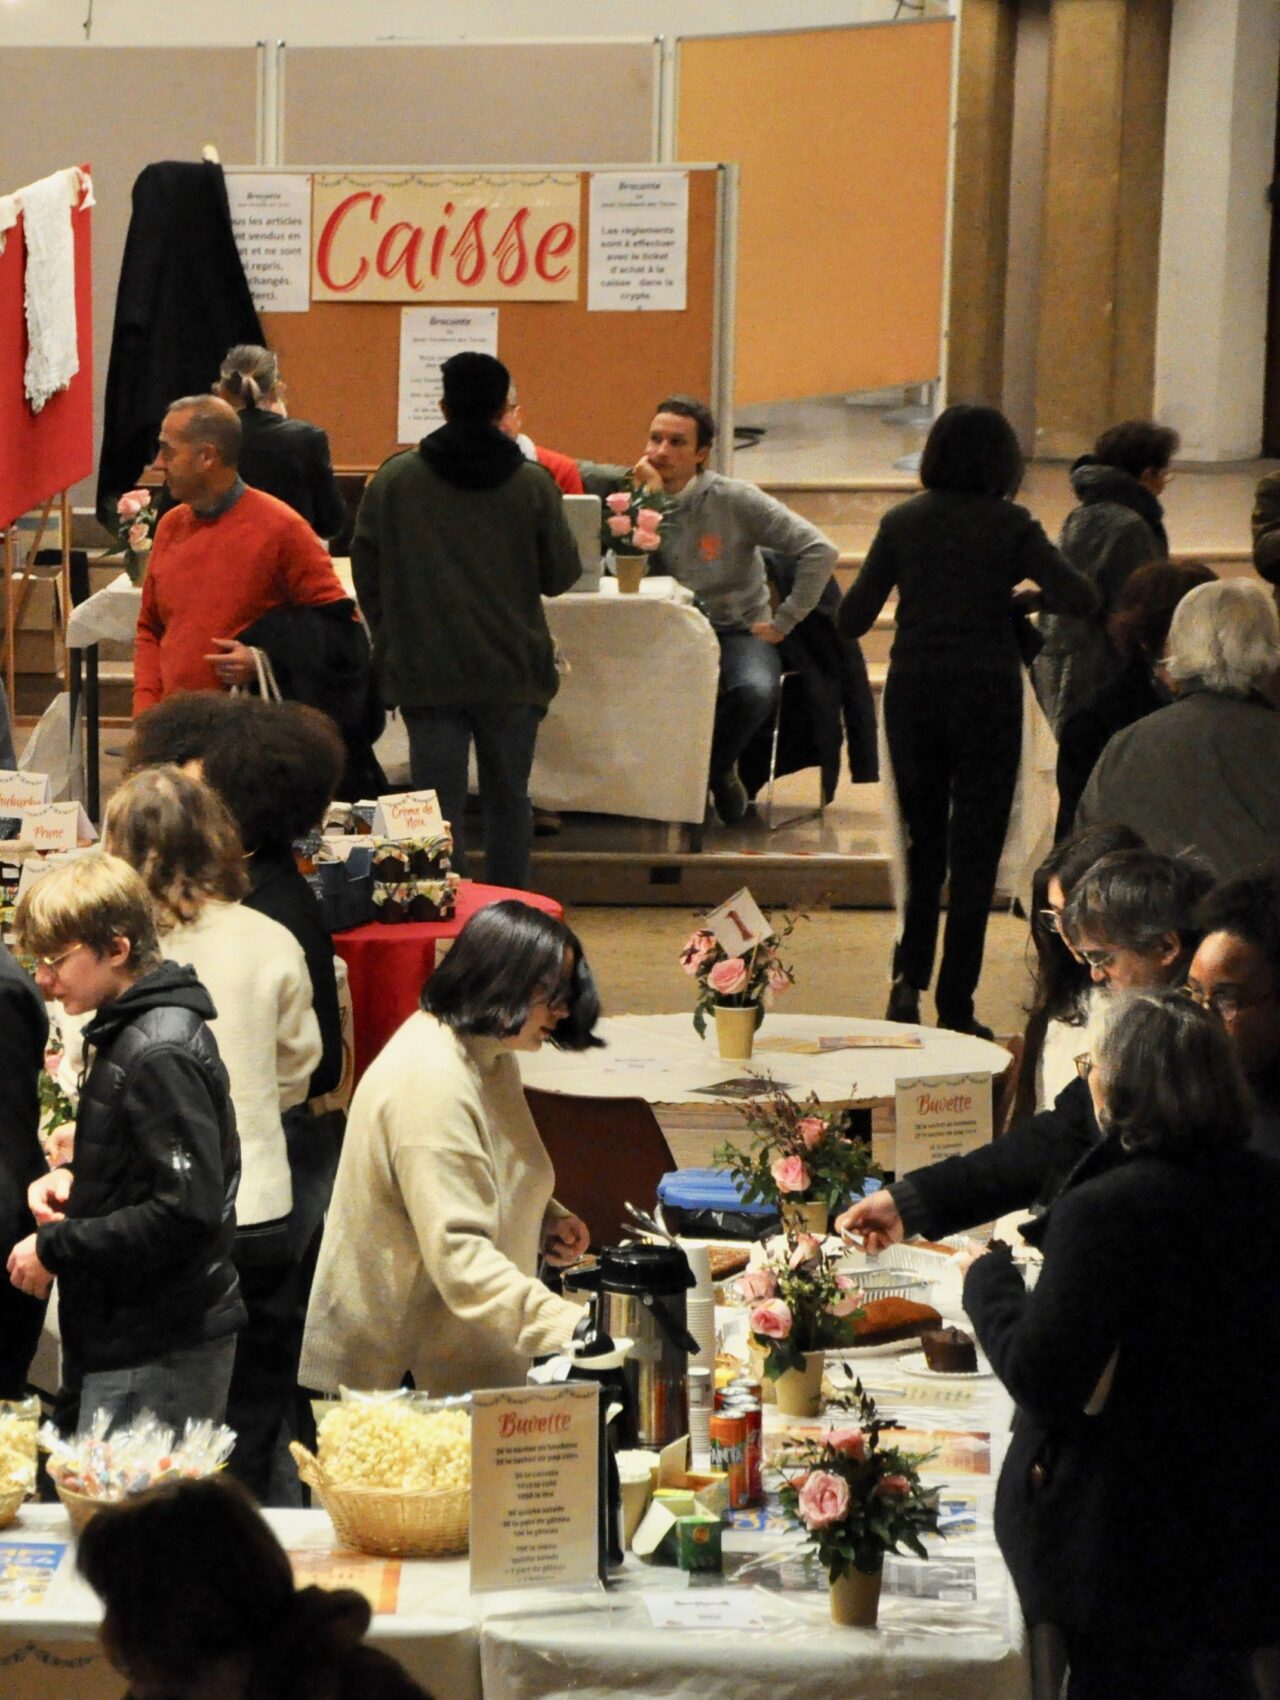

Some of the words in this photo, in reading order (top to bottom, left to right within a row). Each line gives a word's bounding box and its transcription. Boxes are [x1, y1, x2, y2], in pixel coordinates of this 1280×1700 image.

[265, 216, 302, 226] articles
[316, 190, 577, 293] Caisse
[724, 910, 754, 942] 1
[916, 1092, 972, 1116] Buvette
[498, 1410, 572, 1439] Buvette
